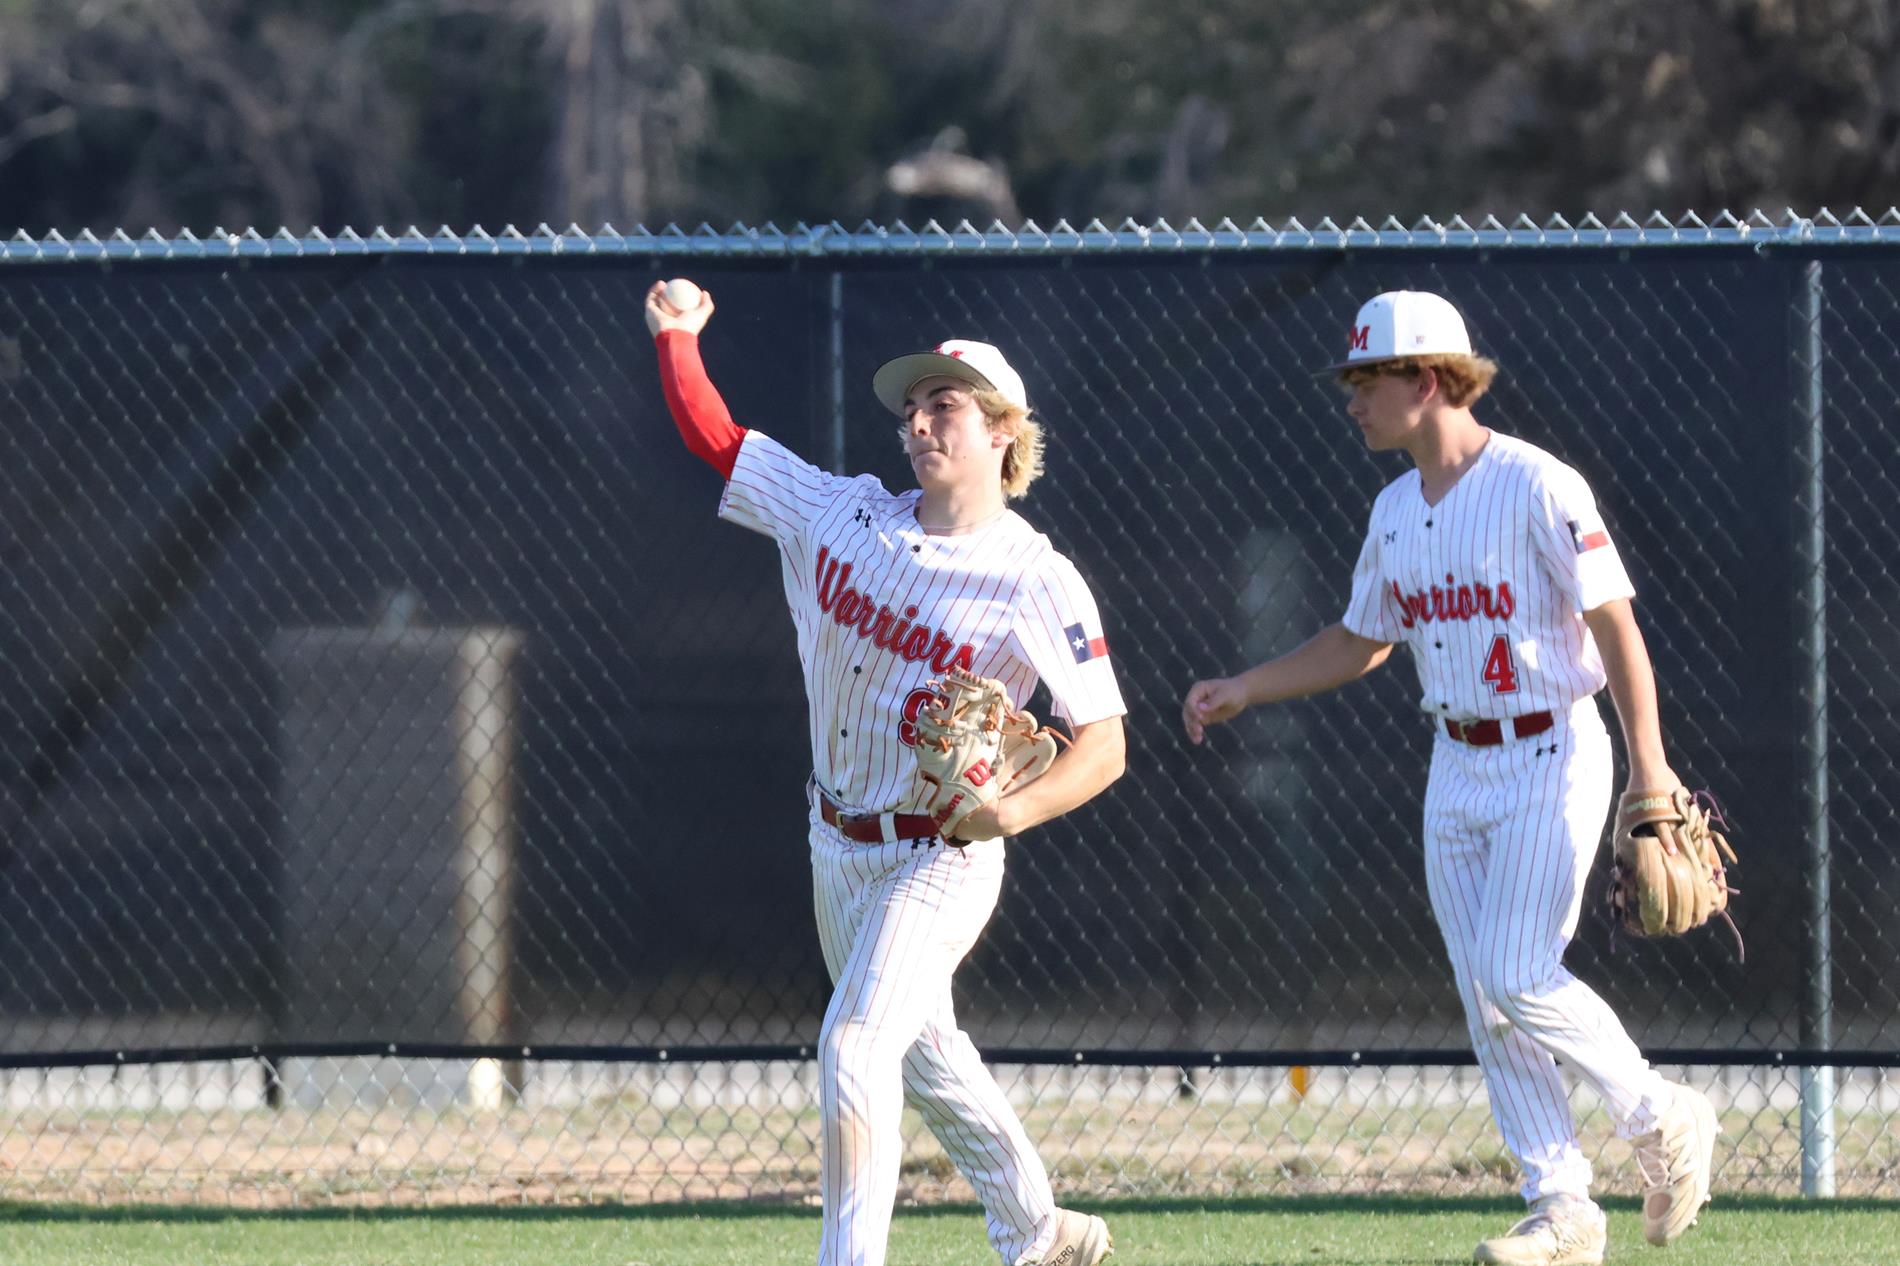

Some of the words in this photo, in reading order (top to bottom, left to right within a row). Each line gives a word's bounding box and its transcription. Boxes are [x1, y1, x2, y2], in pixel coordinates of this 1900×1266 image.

[1349, 325, 1370, 351] M
[816, 544, 975, 676] Warriors
[1392, 572, 1515, 629] rriors
[1482, 633, 1519, 694] 4
